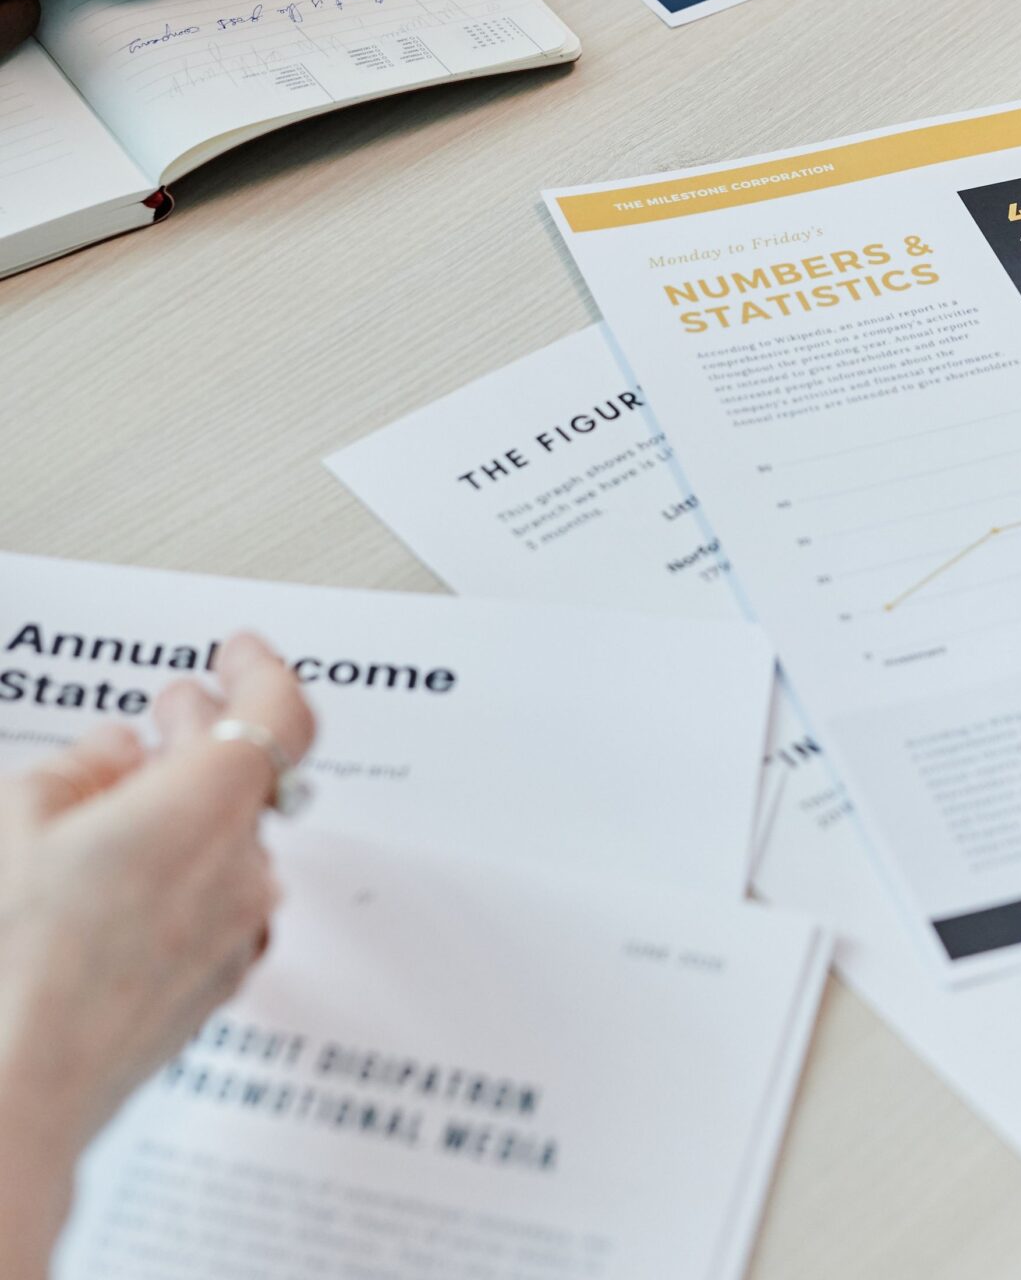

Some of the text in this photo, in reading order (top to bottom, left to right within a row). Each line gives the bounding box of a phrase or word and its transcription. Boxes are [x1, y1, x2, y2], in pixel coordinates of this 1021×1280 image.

[613, 163, 836, 212] THE MILESTONE CORPORATION
[649, 225, 824, 269] Monday to Friday's
[663, 235, 934, 306] NUMBERS &
[679, 263, 940, 334] STATISTICS
[758, 340, 772, 349] to
[839, 323, 853, 331] an
[856, 313, 895, 327] annual
[898, 305, 935, 318] report
[938, 301, 948, 310] is
[777, 358, 798, 369] the
[894, 328, 934, 343] Annual
[937, 318, 980, 334] reports
[794, 339, 831, 353] report
[834, 336, 850, 345] on
[926, 306, 979, 324] activities
[915, 340, 936, 351] and
[938, 332, 969, 346] other
[458, 384, 645, 492] THE FIGUR
[6, 623, 457, 694] Annual come
[0, 669, 151, 716] State
[205, 1020, 307, 1065] BOUT
